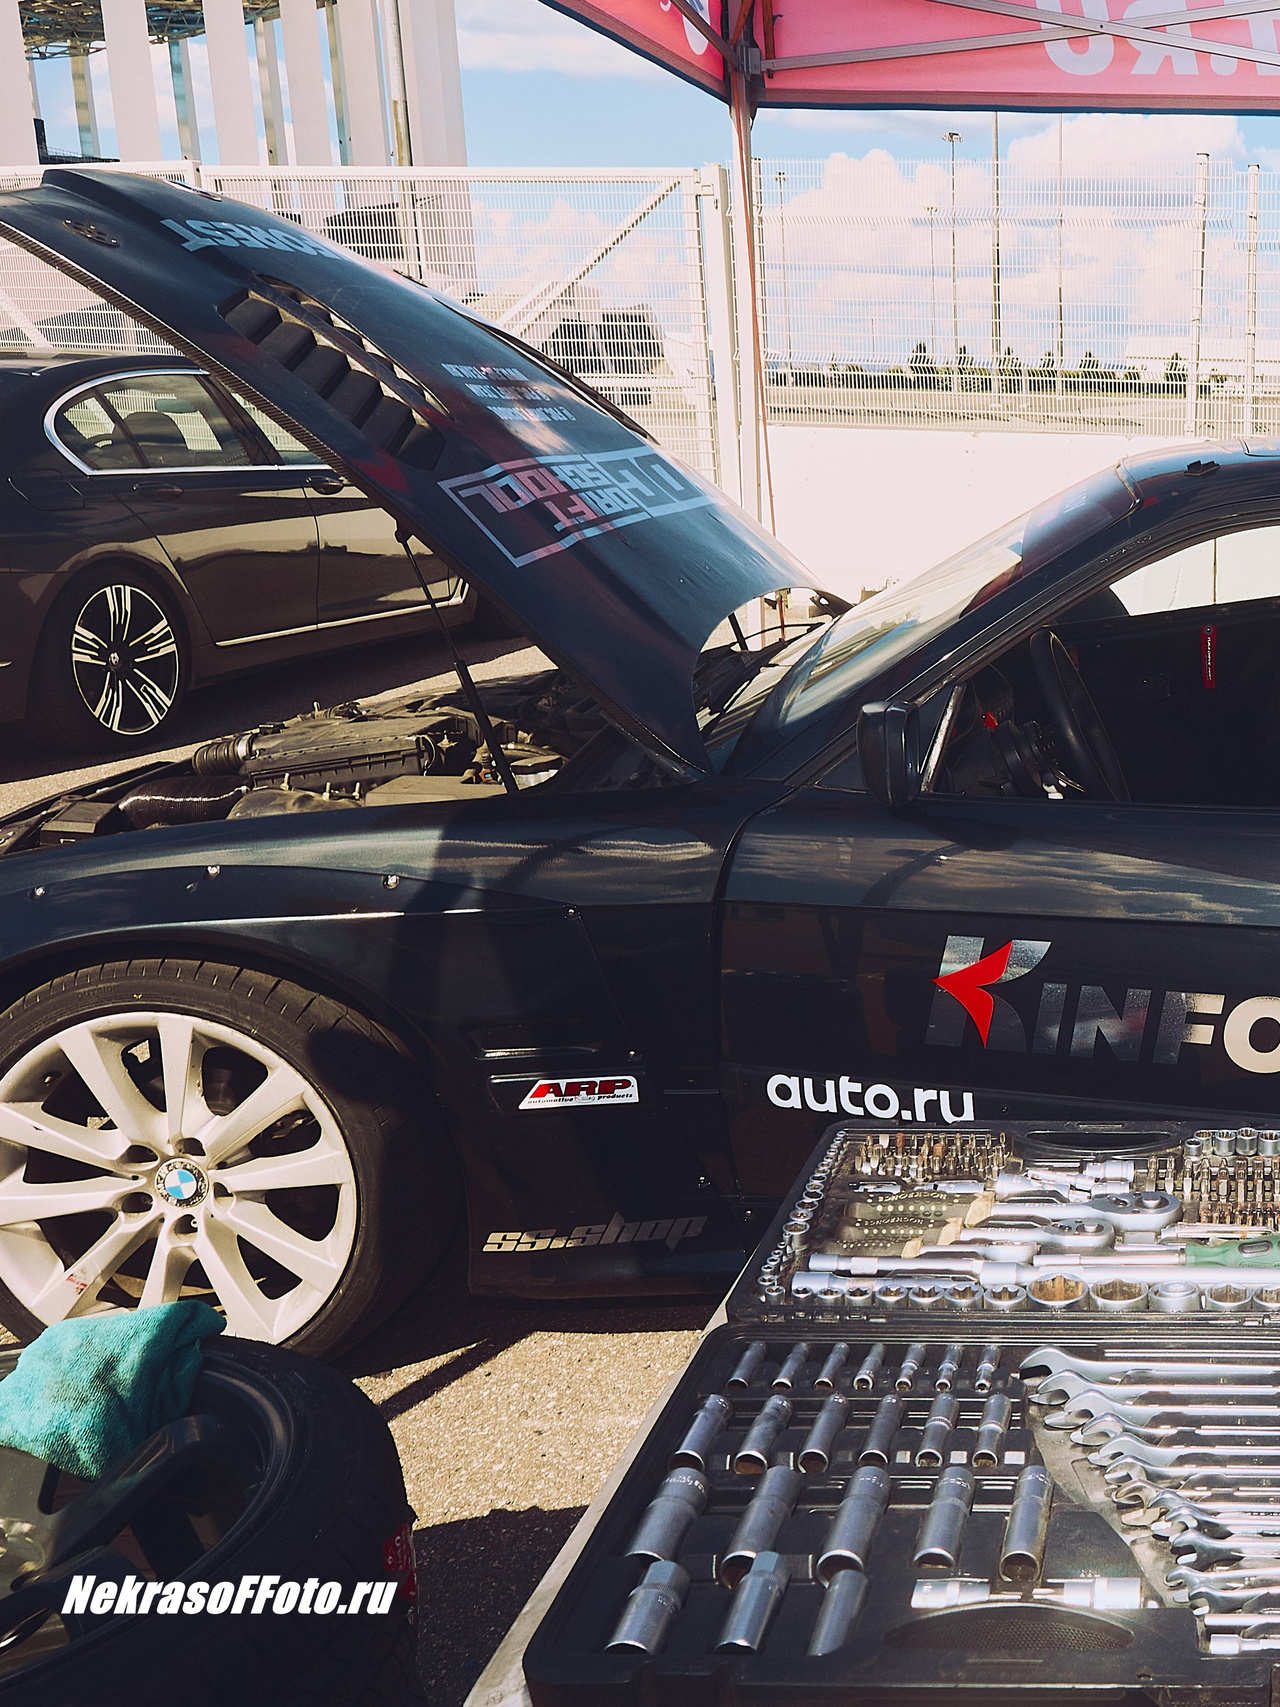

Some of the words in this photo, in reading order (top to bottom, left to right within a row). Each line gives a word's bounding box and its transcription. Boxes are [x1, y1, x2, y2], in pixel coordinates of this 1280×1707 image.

[530, 1079, 631, 1098] ARP
[767, 1074, 974, 1123] auto.ru
[483, 1211, 708, 1250] ss.shop
